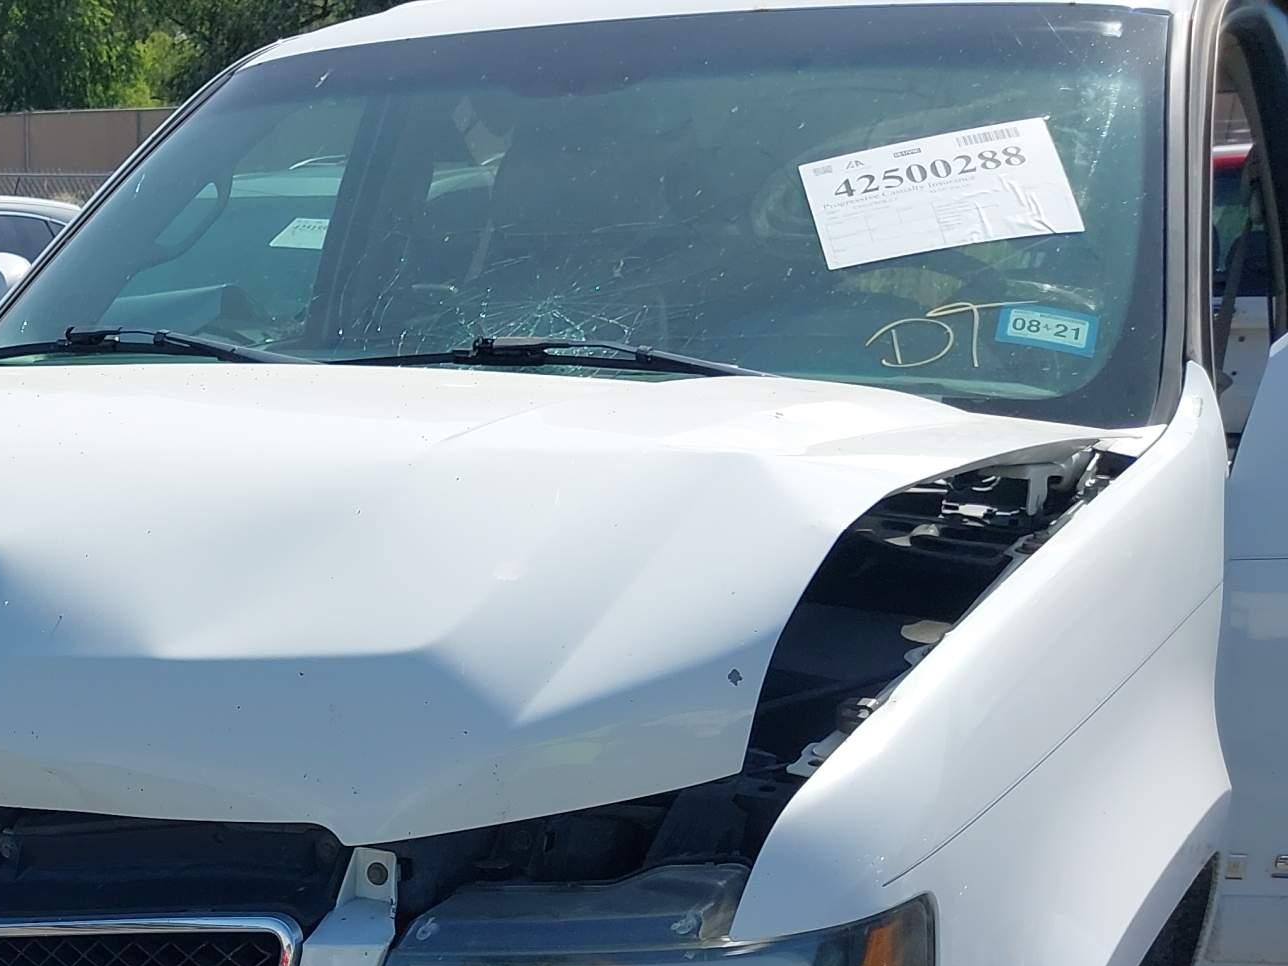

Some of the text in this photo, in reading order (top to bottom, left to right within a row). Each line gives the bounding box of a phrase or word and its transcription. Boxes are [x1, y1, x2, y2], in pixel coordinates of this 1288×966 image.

[834, 146, 1027, 198] 42500288
[1012, 317, 1041, 333] 08
[1053, 323, 1080, 341] 21
